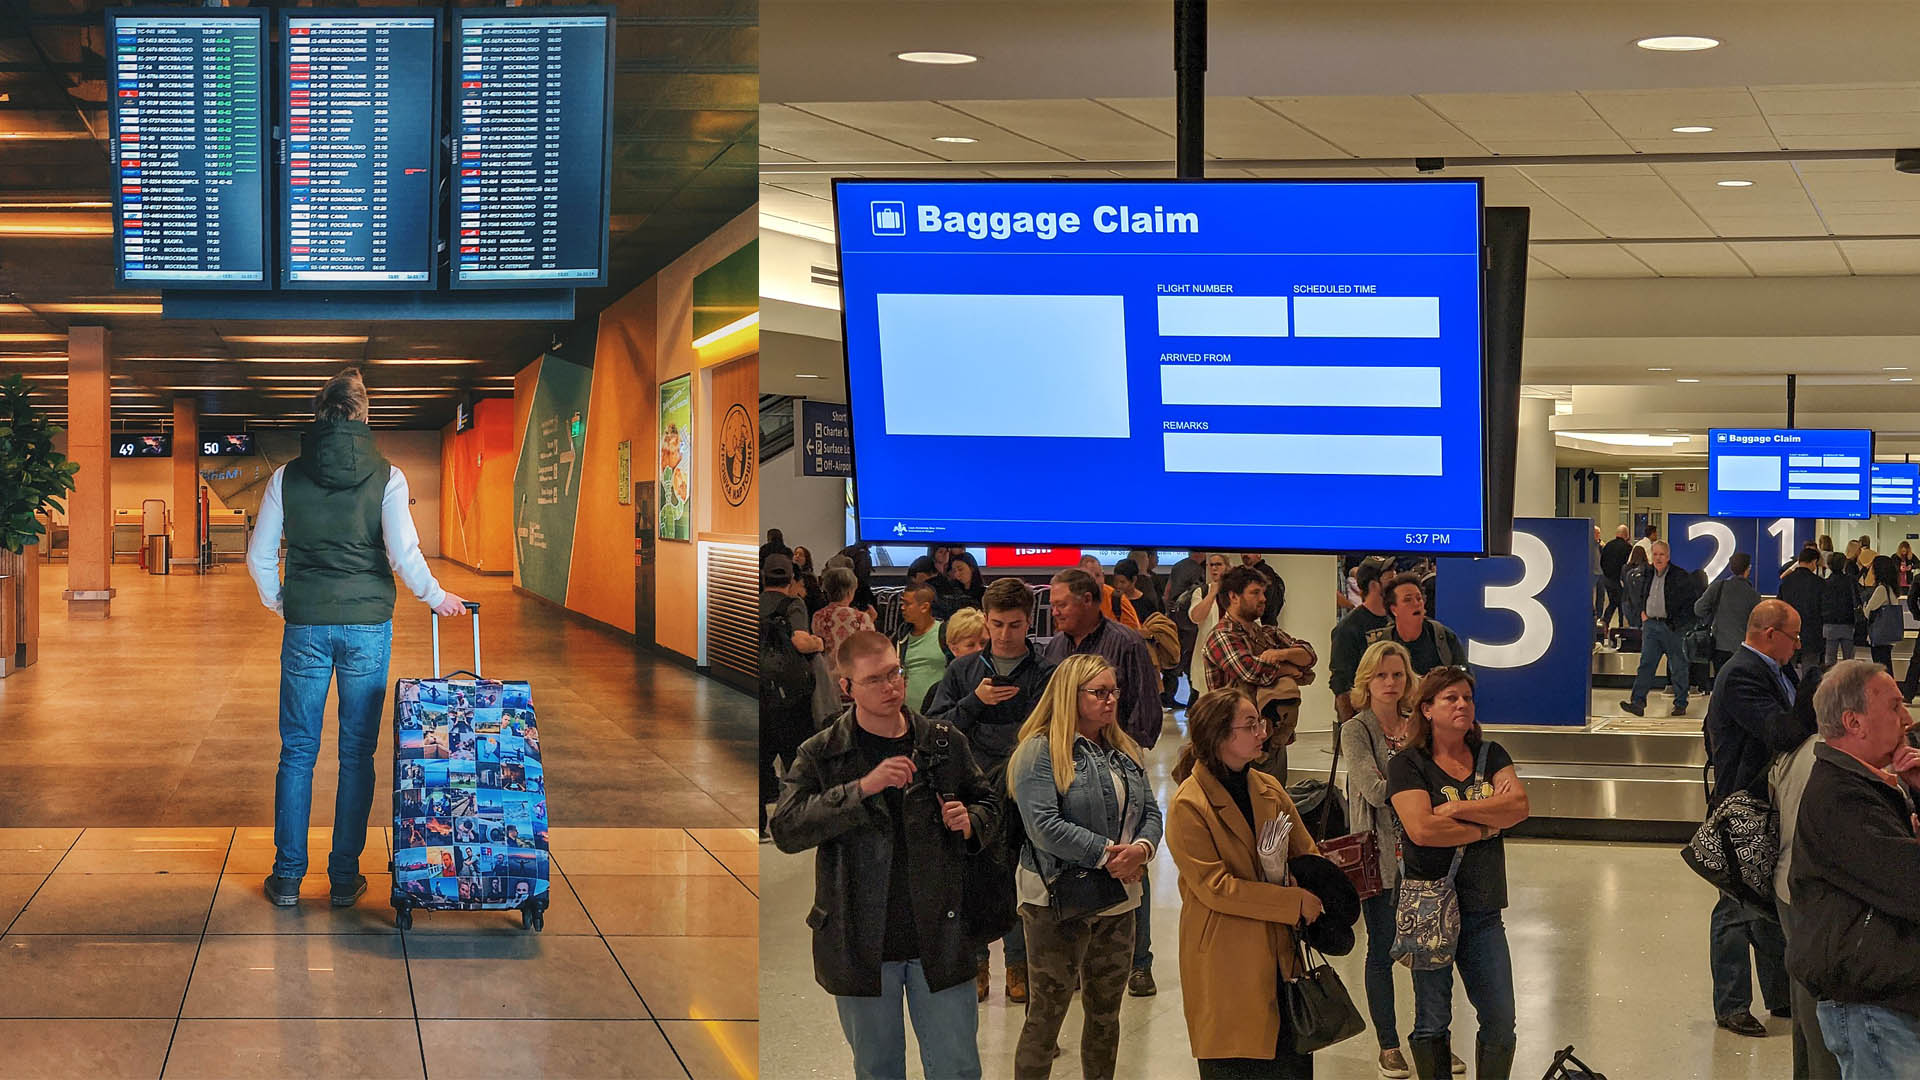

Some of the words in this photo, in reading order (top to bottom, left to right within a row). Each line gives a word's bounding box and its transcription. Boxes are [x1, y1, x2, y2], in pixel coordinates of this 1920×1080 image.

[917, 205, 1081, 240] Baggage
[1093, 205, 1199, 234] Claim
[1157, 283, 1191, 293] FLIGHT
[1192, 284, 1234, 293] NUMBER
[1293, 284, 1352, 294] SCHEDULED
[1353, 284, 1377, 294] TIME
[1159, 353, 1202, 362] ARRIVED
[1203, 353, 1232, 362] FROM
[823, 425, 843, 437] Charter
[1162, 421, 1209, 430] REMARKS
[1729, 434, 1772, 444] Baggage
[1773, 434, 1801, 443] Claim
[118, 443, 134, 456] 49
[203, 442, 219, 455] 50
[823, 442, 844, 454] Surface
[1573, 468, 1599, 504] 11
[1405, 533, 1429, 544] 5:37
[1432, 533, 1450, 545] PM
[1767, 518, 1795, 568] 1
[1688, 521, 1737, 585] 2
[1467, 530, 1554, 669] 3
